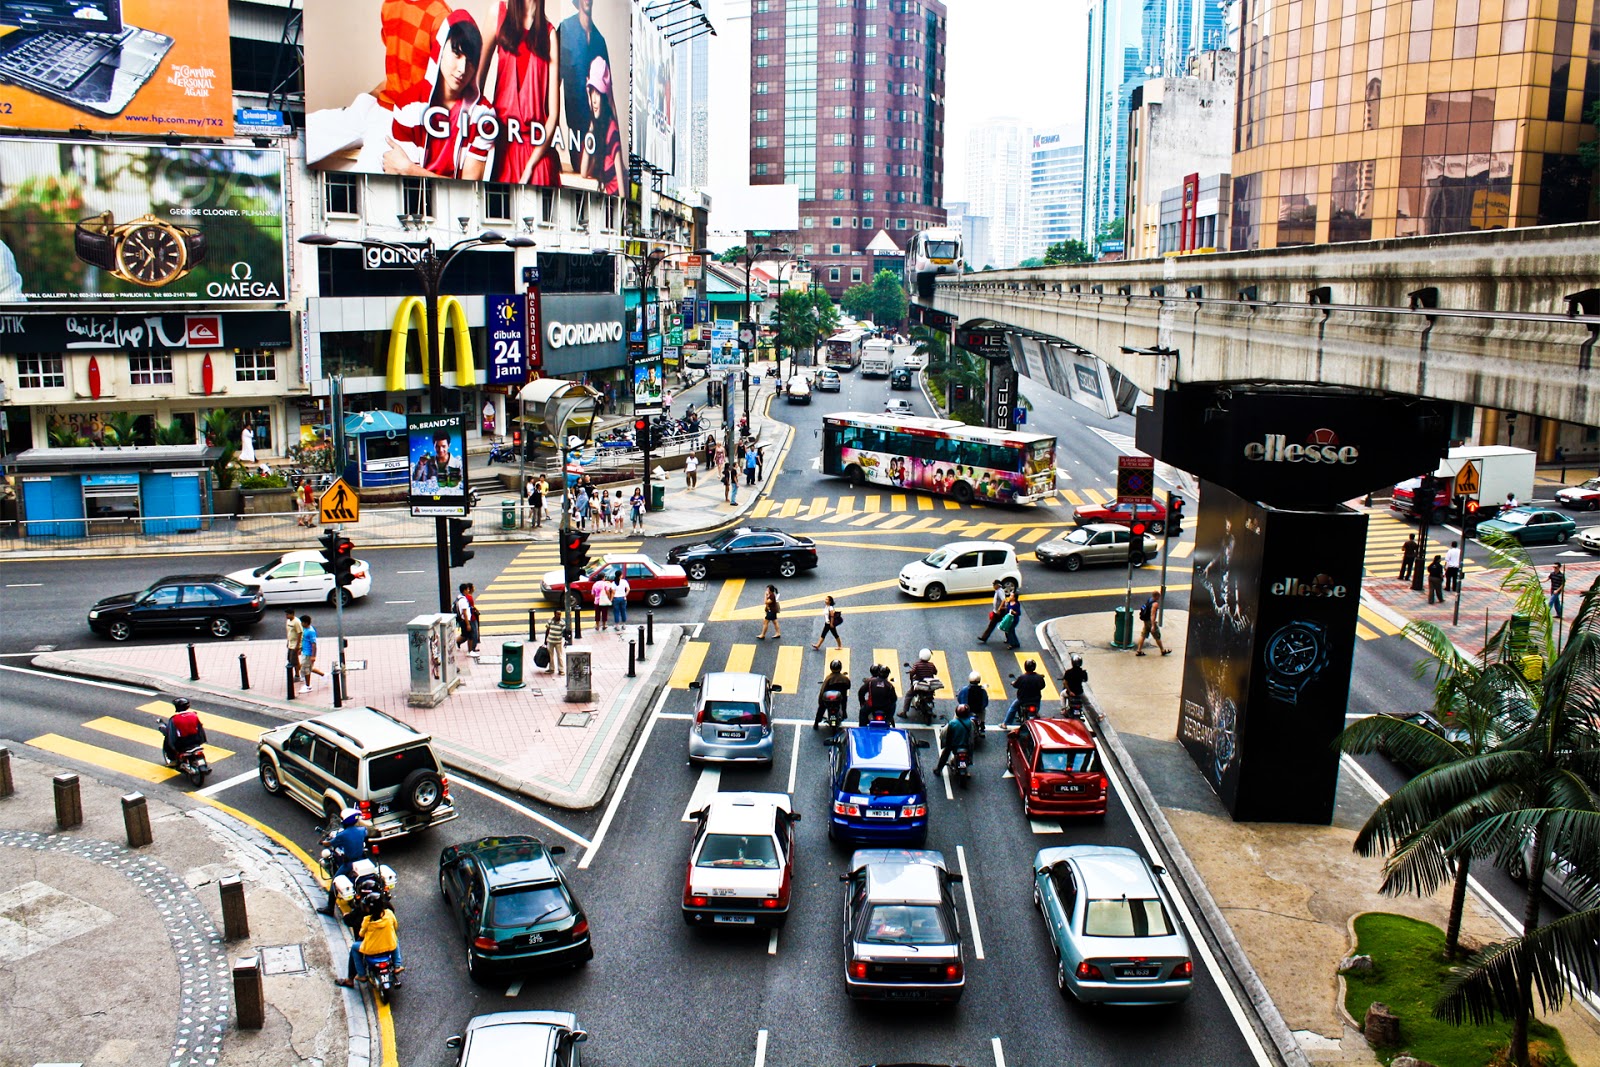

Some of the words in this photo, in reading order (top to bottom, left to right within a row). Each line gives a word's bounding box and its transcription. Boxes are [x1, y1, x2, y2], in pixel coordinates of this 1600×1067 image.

[125, 114, 224, 127] www.hp.com.my/TX2
[423, 106, 597, 155] GIORDANO
[169, 208, 201, 216] GEORGE
[206, 281, 281, 298] OMEGA
[493, 330, 521, 339] dibuka
[528, 292, 538, 360] McDonald's
[547, 321, 623, 349] GIORDANO
[494, 340, 521, 364] 24
[496, 365, 521, 378] jam
[420, 417, 460, 430] BRAND'S!
[1243, 434, 1359, 464] ellesse
[1271, 577, 1347, 598] ellesse
